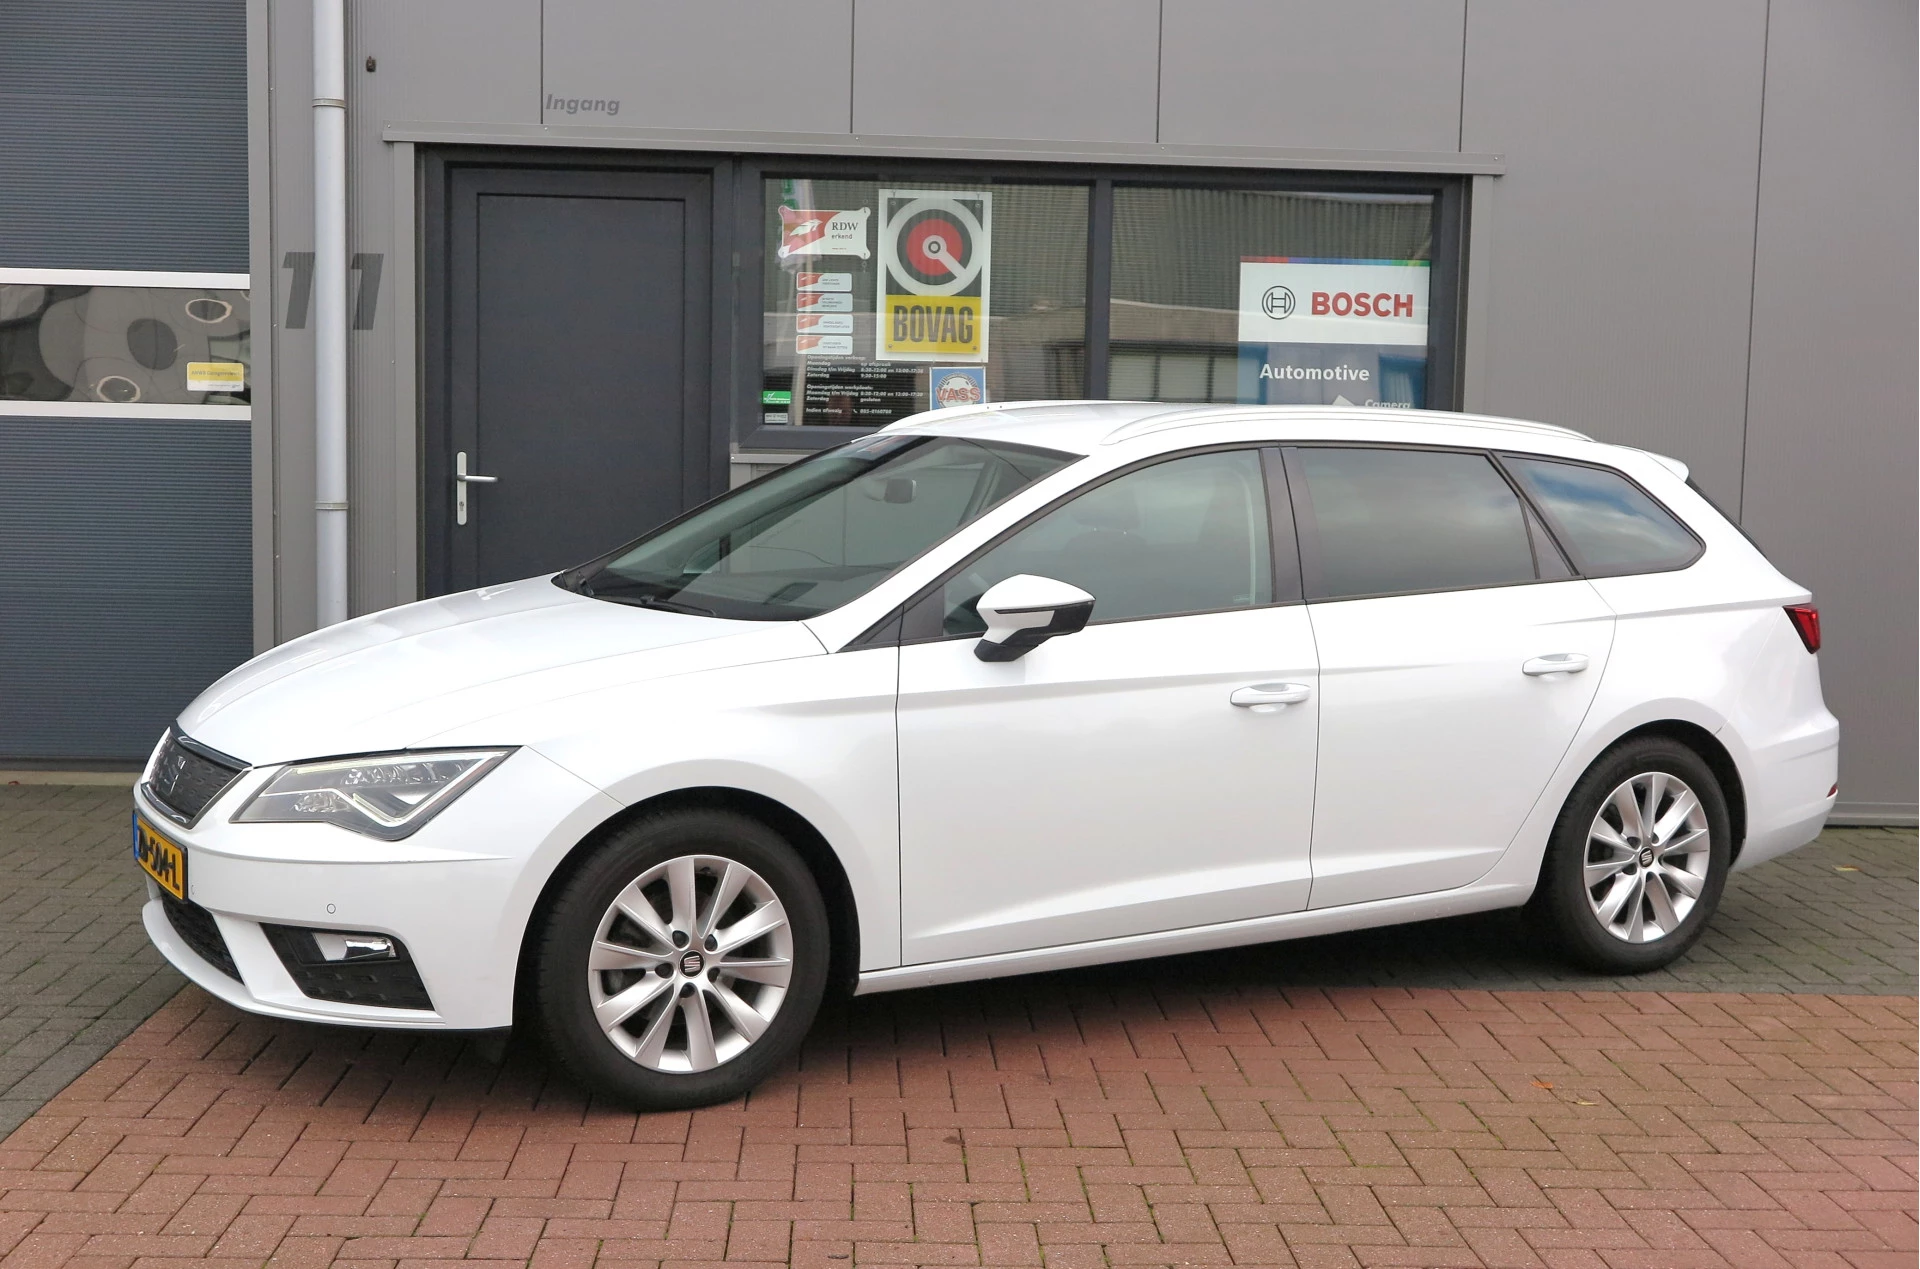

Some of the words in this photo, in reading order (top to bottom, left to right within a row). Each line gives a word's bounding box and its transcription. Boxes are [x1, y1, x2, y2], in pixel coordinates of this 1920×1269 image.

[546, 93, 620, 116] Ingang
[831, 222, 859, 231] RDW
[1311, 291, 1413, 318] BOSCH
[893, 305, 974, 344] BOVAG
[1259, 363, 1370, 381] Automotive
[935, 387, 981, 402] VASS
[1364, 399, 1411, 408] Camera
